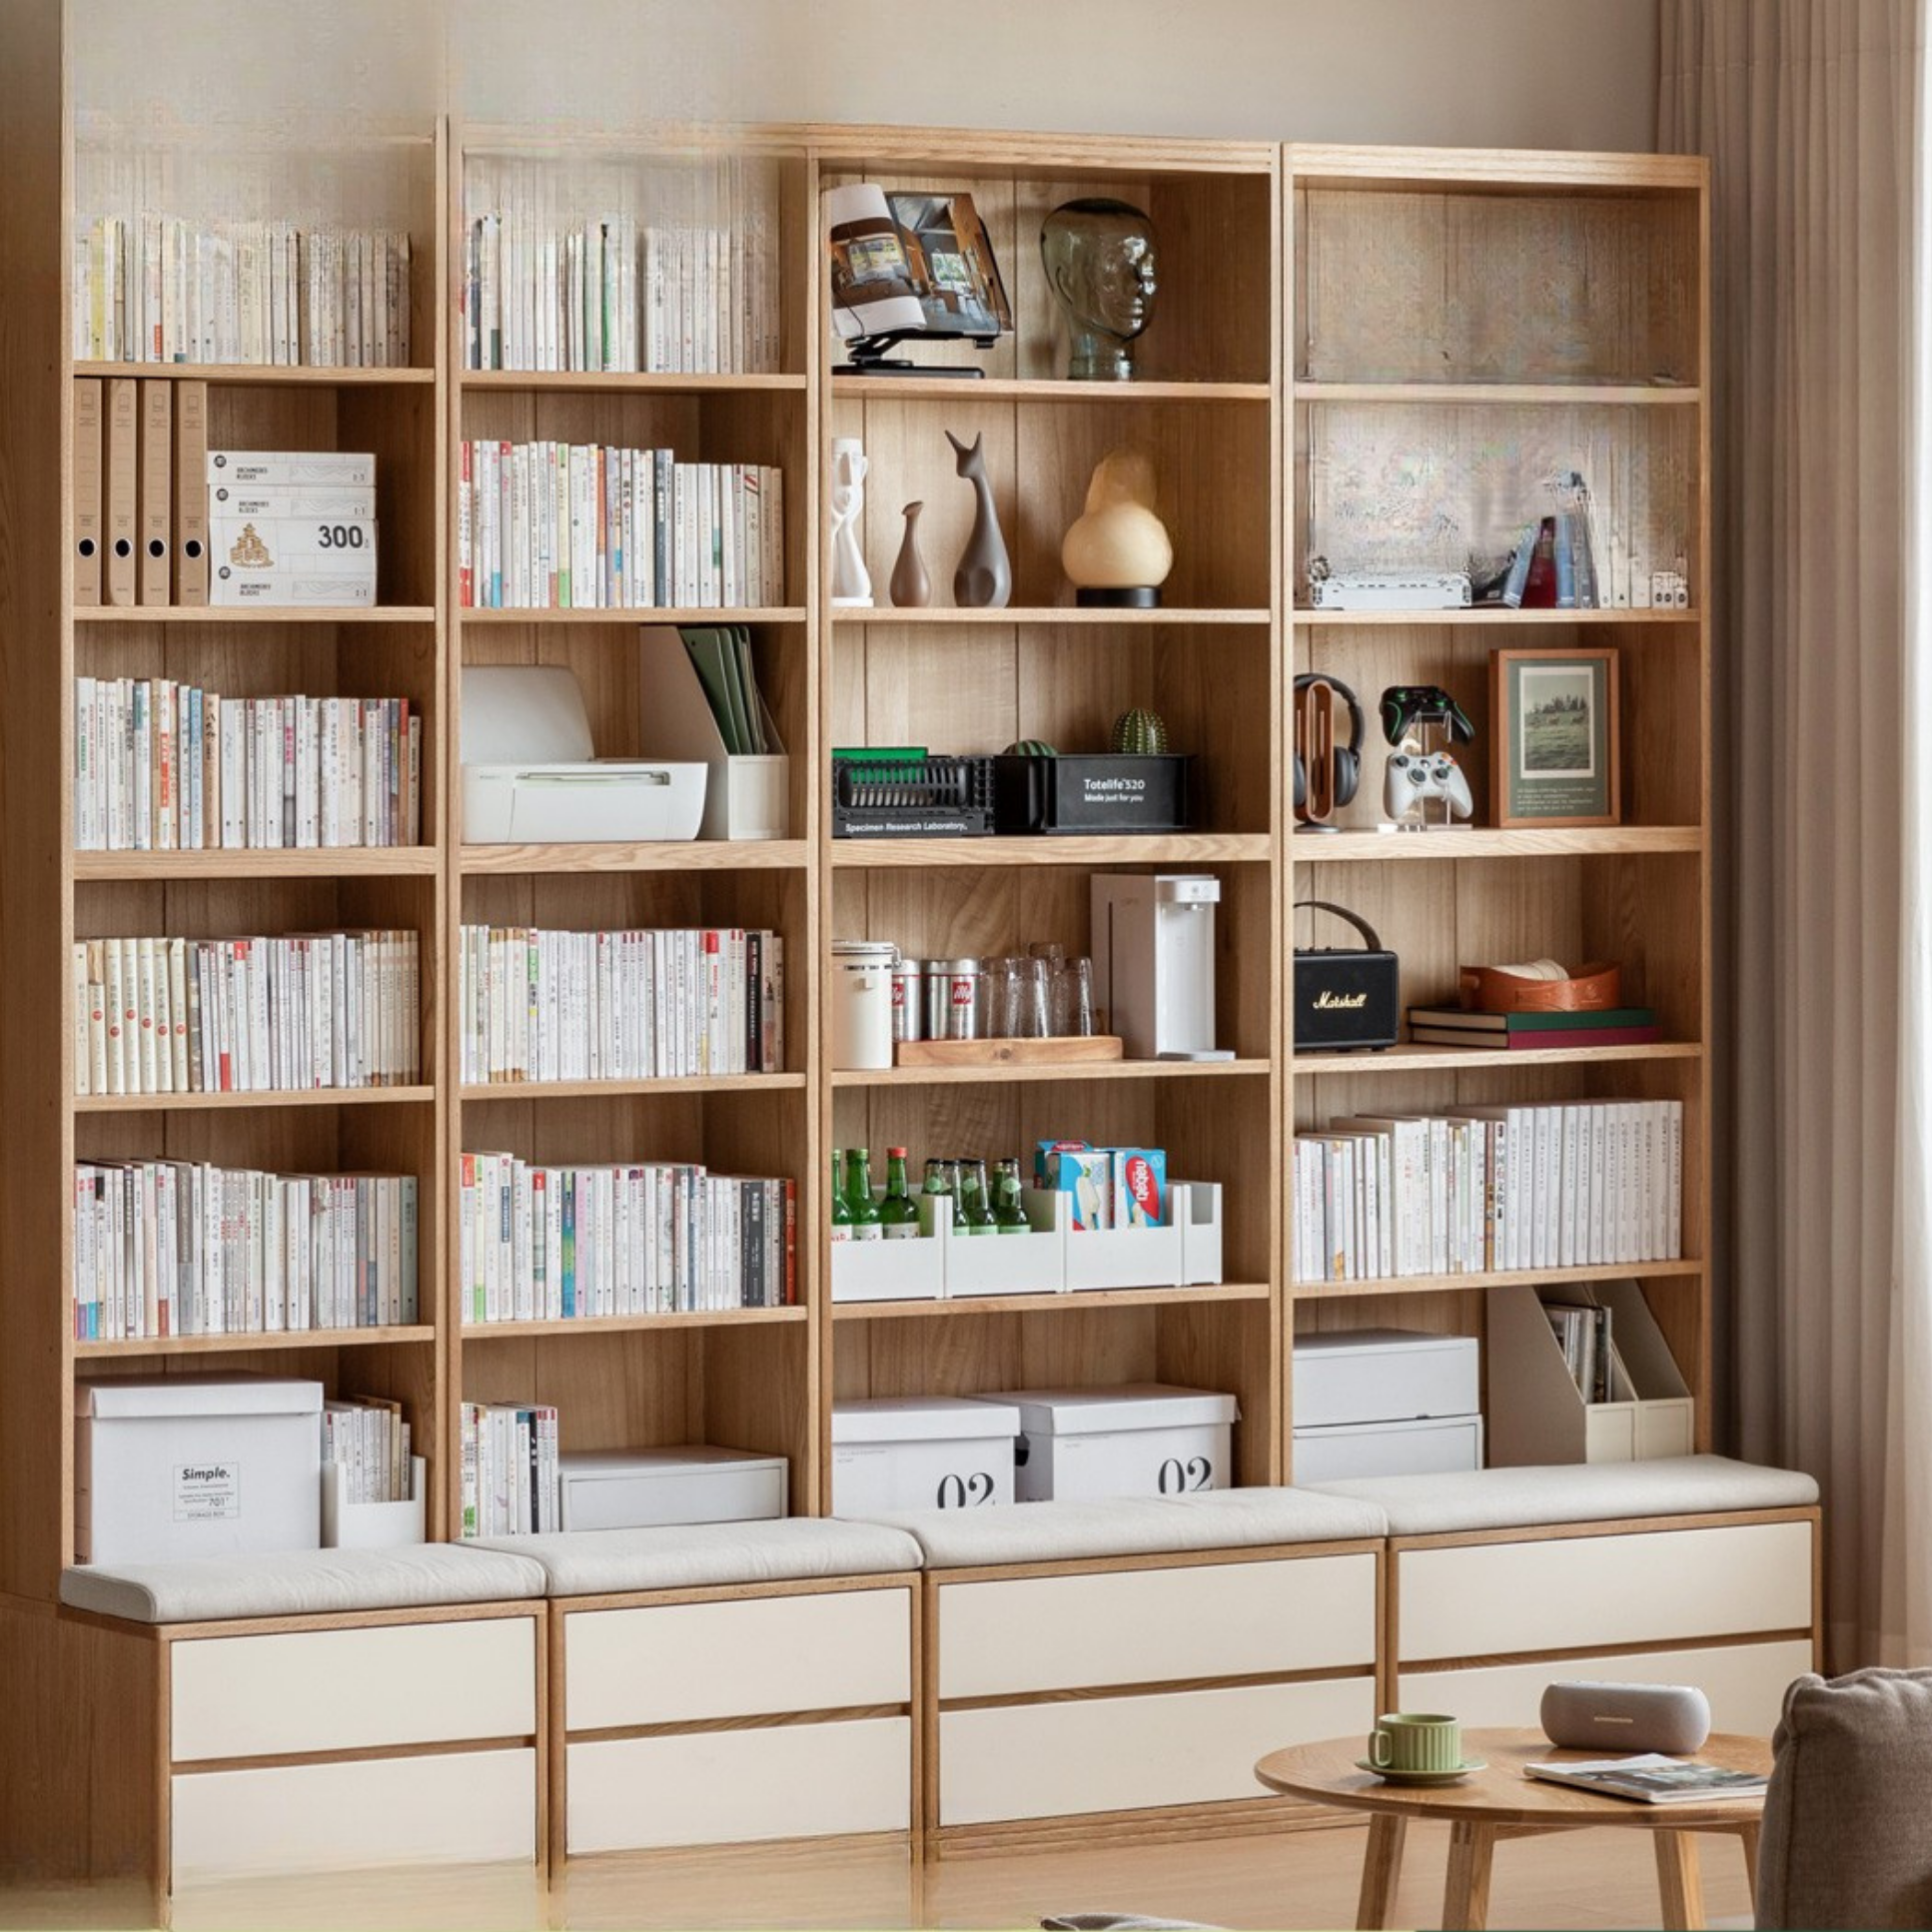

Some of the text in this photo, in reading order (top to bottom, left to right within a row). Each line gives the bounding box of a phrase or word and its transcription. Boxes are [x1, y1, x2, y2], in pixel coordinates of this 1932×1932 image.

[318, 524, 364, 549] 300
[845, 823, 884, 833] Specimen
[885, 822, 922, 831] Research
[1313, 991, 1367, 1010] Marshall
[181, 1465, 231, 1482] Simple.
[1157, 1454, 1213, 1494] 02
[937, 1471, 995, 1509] 02
